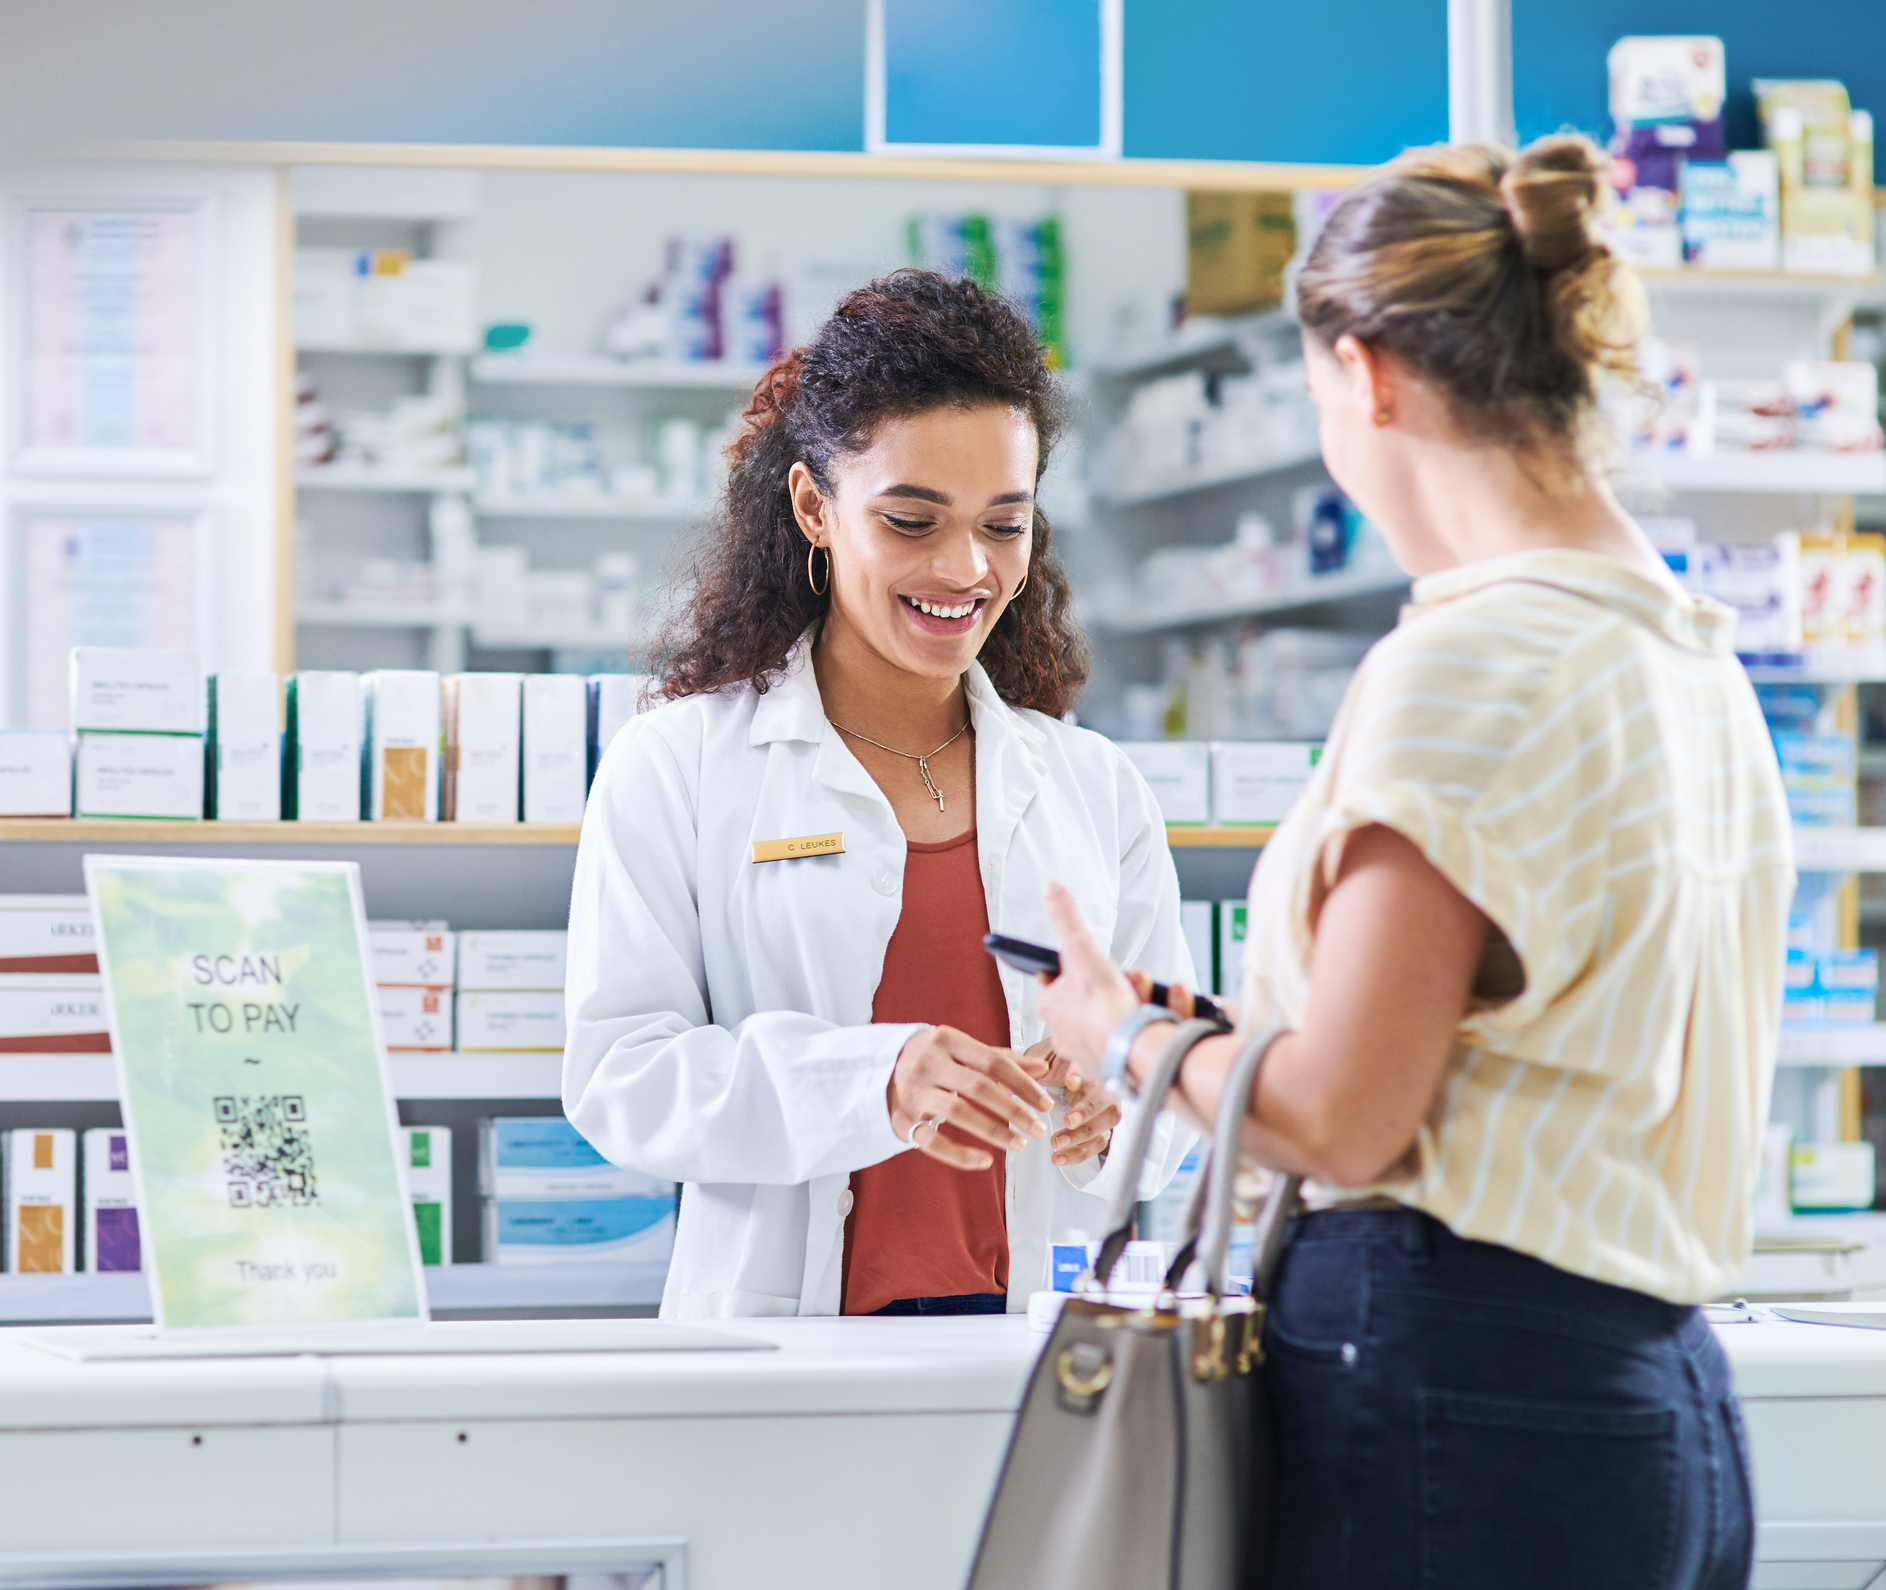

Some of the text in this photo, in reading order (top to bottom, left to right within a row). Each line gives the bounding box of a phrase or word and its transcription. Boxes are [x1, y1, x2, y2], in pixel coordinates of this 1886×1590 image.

[801, 839, 836, 850] LEUKES
[193, 954, 282, 985] SCAN
[187, 1002, 299, 1033] TO PAY
[235, 1259, 338, 1285] Thank you
